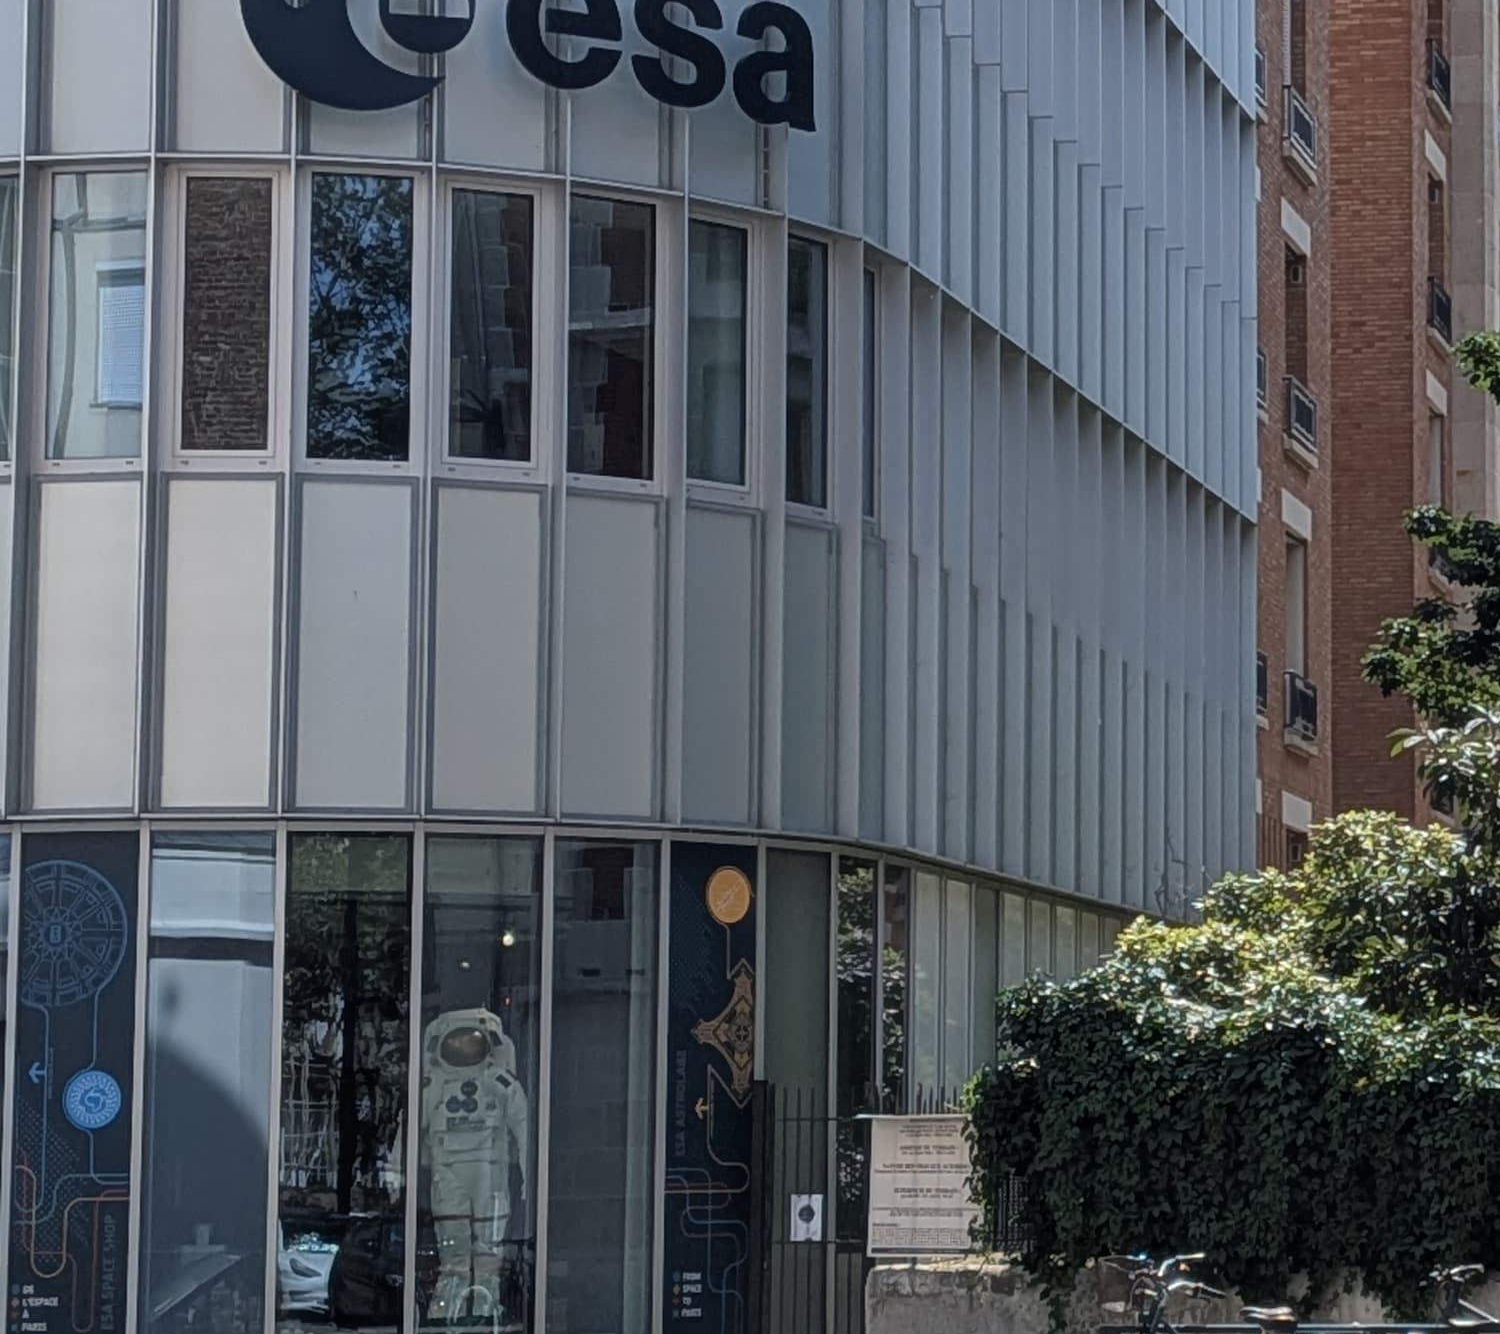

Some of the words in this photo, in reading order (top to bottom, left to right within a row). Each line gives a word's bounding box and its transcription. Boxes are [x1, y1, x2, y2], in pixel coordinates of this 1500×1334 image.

[103, 1214, 116, 1252] SHOP
[102, 1257, 115, 1299] SPACE
[101, 1305, 114, 1330] ESA
